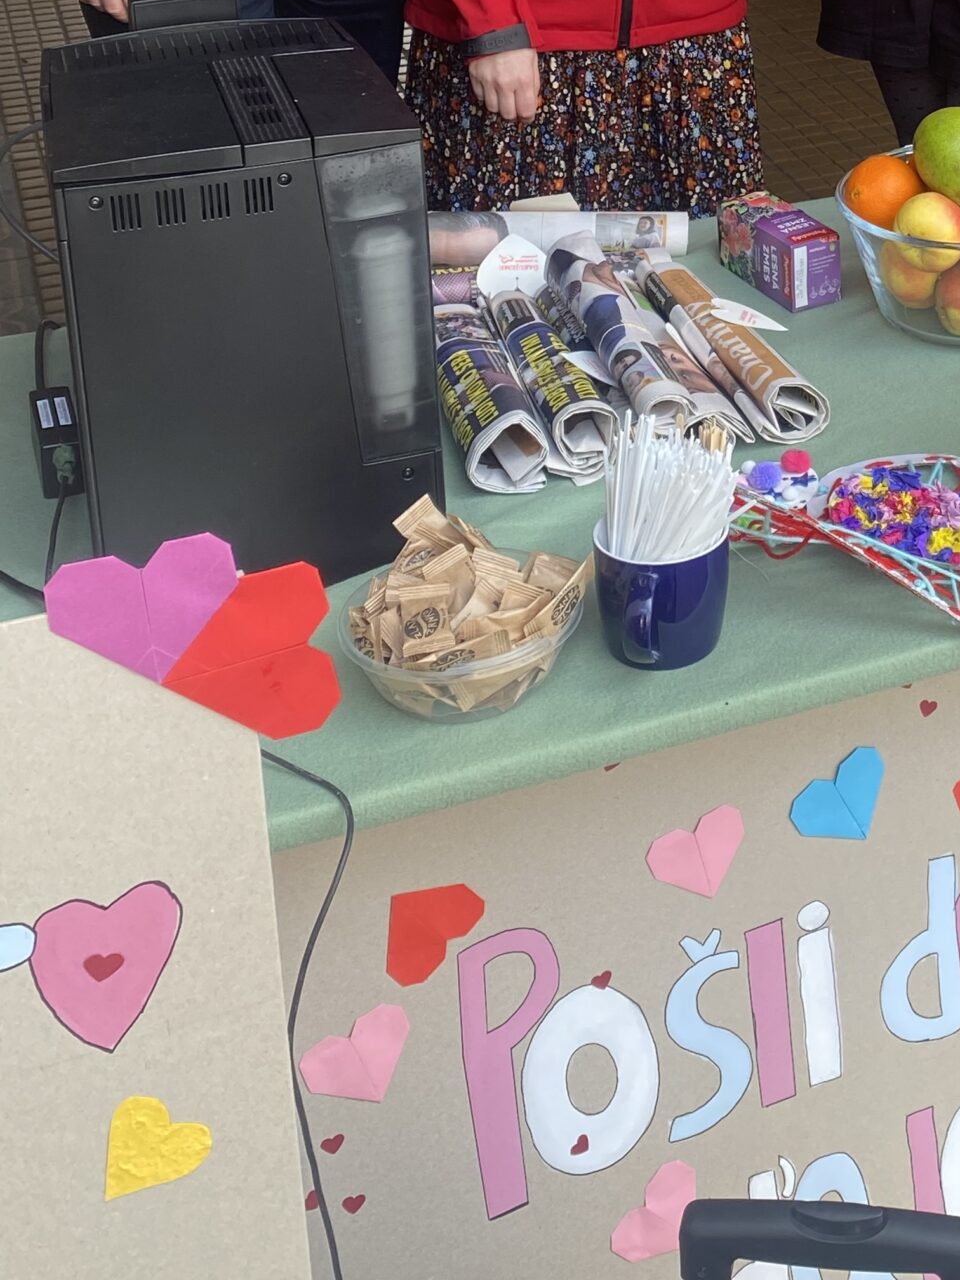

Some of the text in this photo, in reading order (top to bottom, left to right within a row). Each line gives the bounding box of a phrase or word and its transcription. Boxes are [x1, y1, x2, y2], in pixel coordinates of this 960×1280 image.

[762, 243, 771, 283] ZMES
[460, 368, 491, 408] OKOLO
[457, 900, 842, 1220] Pošli
